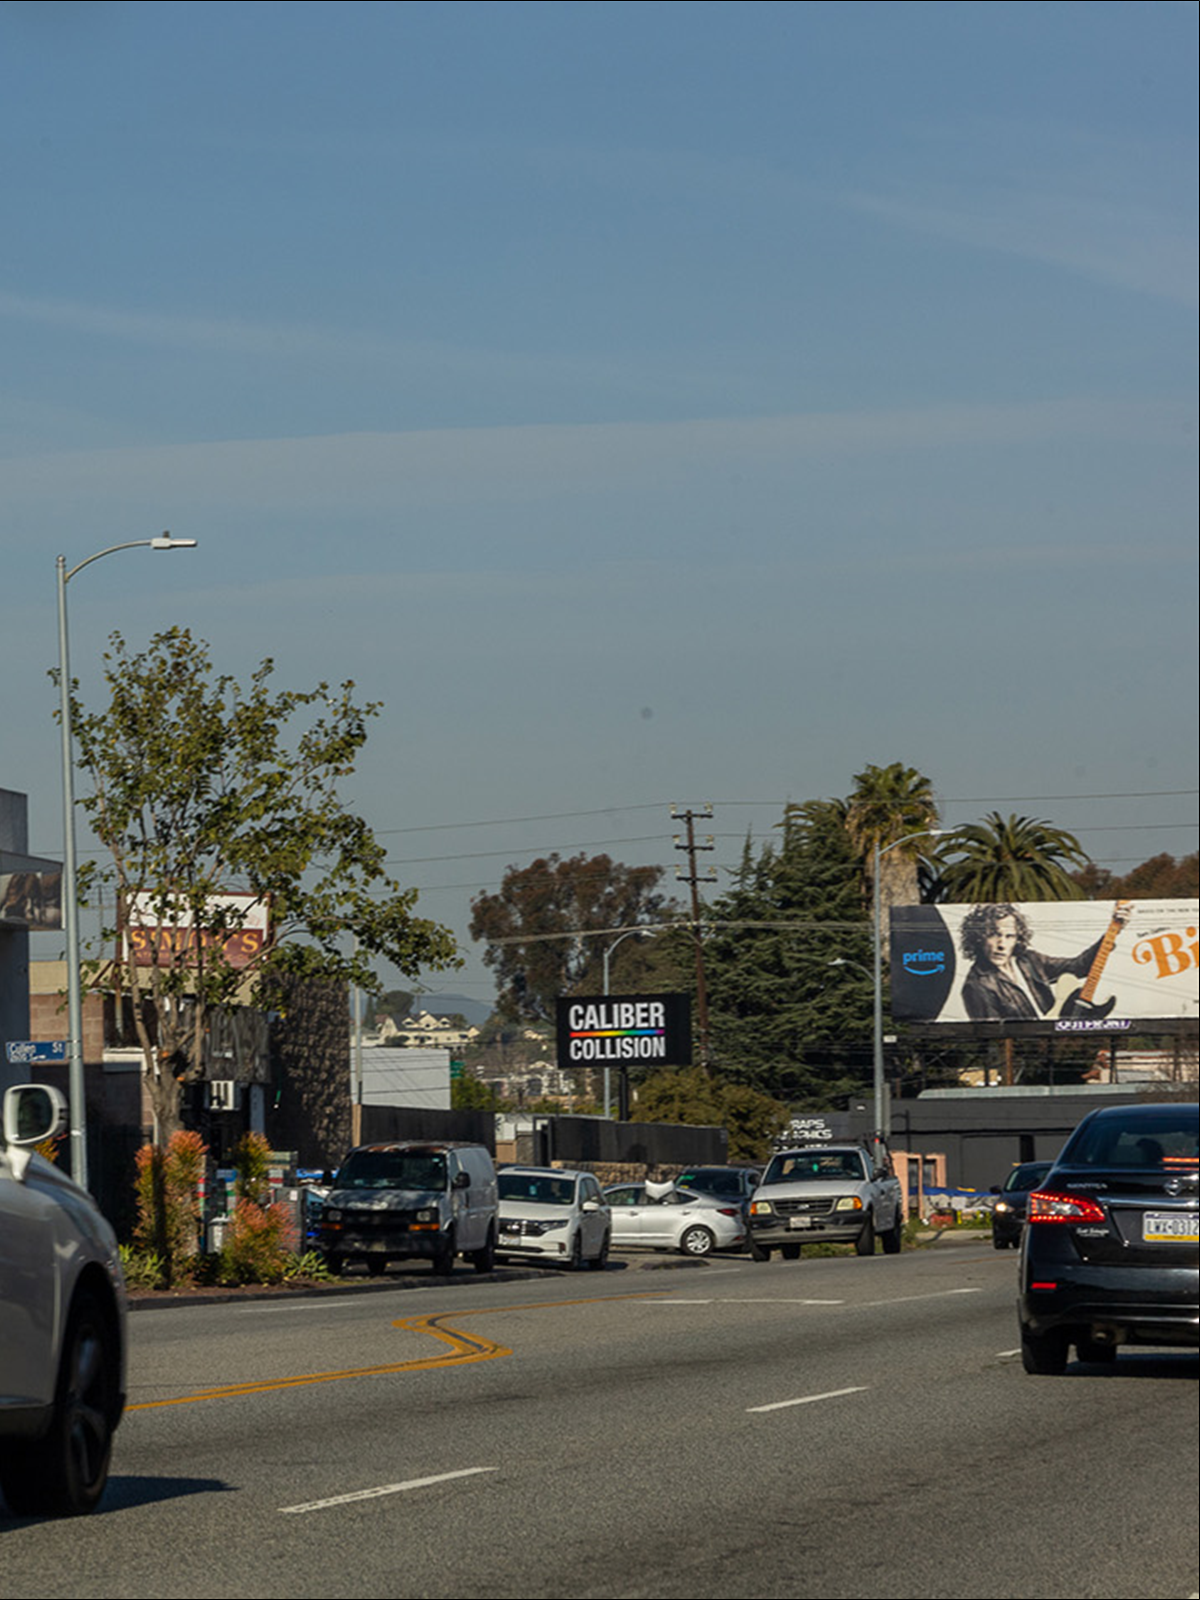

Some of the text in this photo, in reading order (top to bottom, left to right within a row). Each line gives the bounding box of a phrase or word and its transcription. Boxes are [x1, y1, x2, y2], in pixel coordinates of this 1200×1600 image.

[903, 949, 945, 965] prime
[569, 1001, 666, 1030] CALIBER
[52, 1042, 63, 1053] St
[569, 1036, 666, 1061] COLLISION
